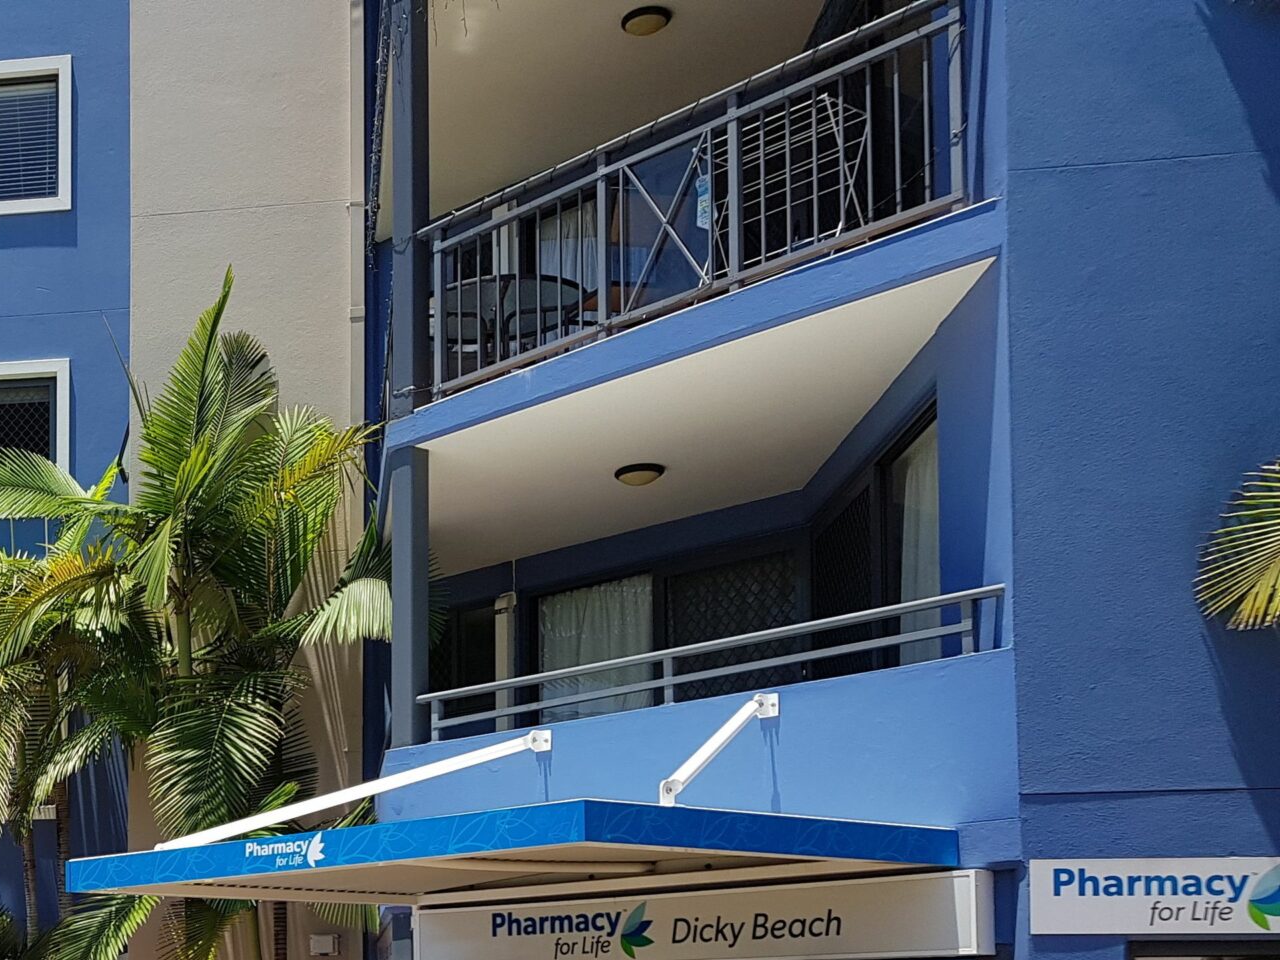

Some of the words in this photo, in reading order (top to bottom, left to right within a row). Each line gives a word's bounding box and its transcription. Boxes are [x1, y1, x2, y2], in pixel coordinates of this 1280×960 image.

[245, 840, 309, 857] Pharmacy
[275, 855, 288, 868] for
[289, 854, 304, 867] Life
[1052, 868, 1250, 903] Pharmacy
[1149, 900, 1185, 927] for
[1191, 900, 1234, 927] Life
[491, 910, 622, 938] Pharmacy
[671, 916, 745, 948] Dicky
[752, 909, 842, 940] Beach
[554, 937, 578, 960] for
[581, 935, 612, 957] Life
